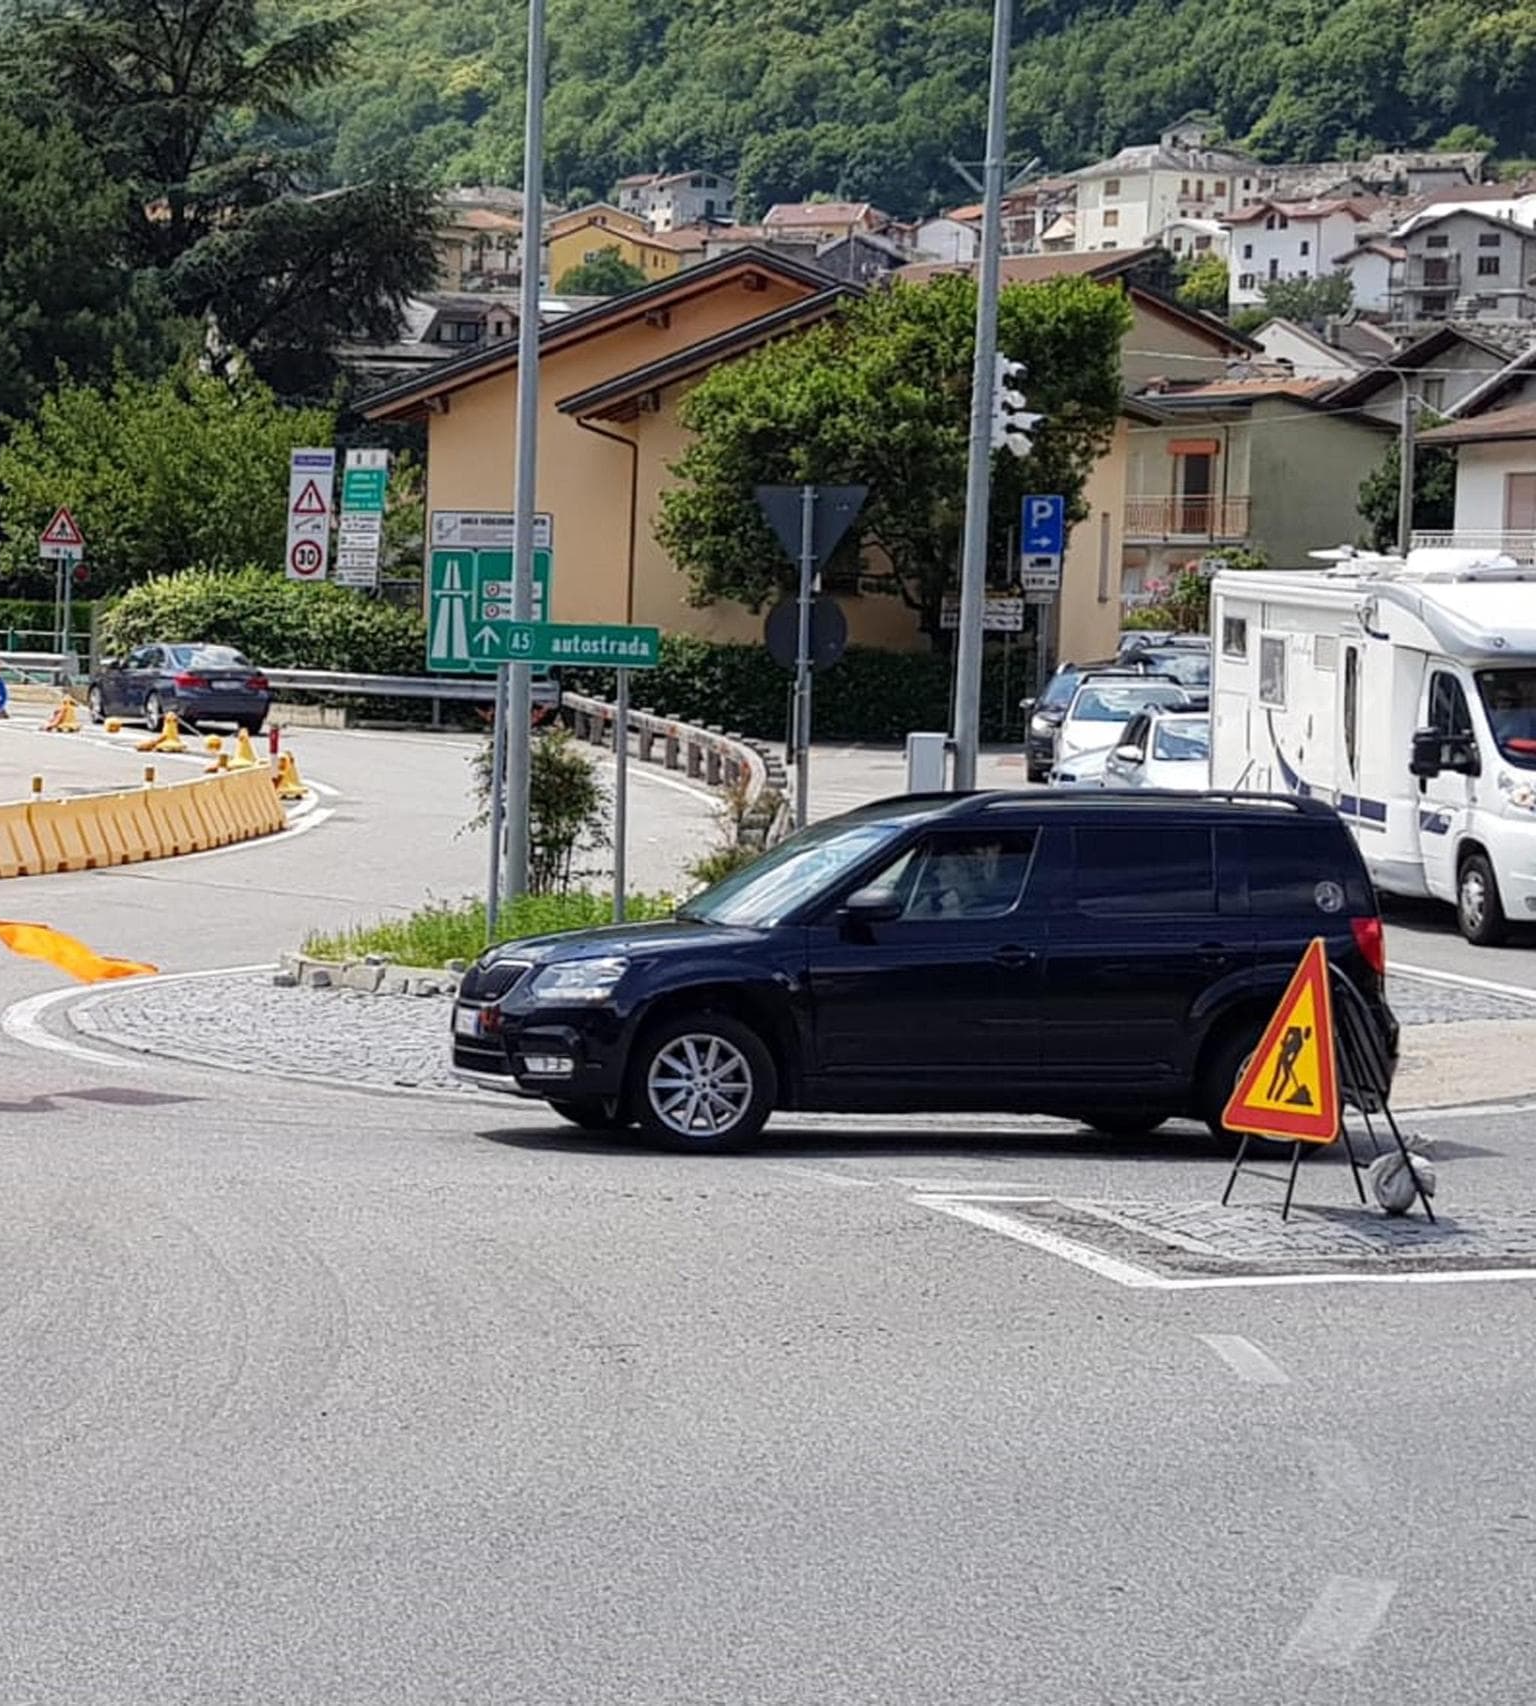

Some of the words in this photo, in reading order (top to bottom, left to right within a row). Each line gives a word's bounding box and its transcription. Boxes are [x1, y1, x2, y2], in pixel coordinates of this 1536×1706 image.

[1031, 500, 1053, 528] P
[511, 632, 530, 650] A5
[551, 634, 650, 657] autostrada
